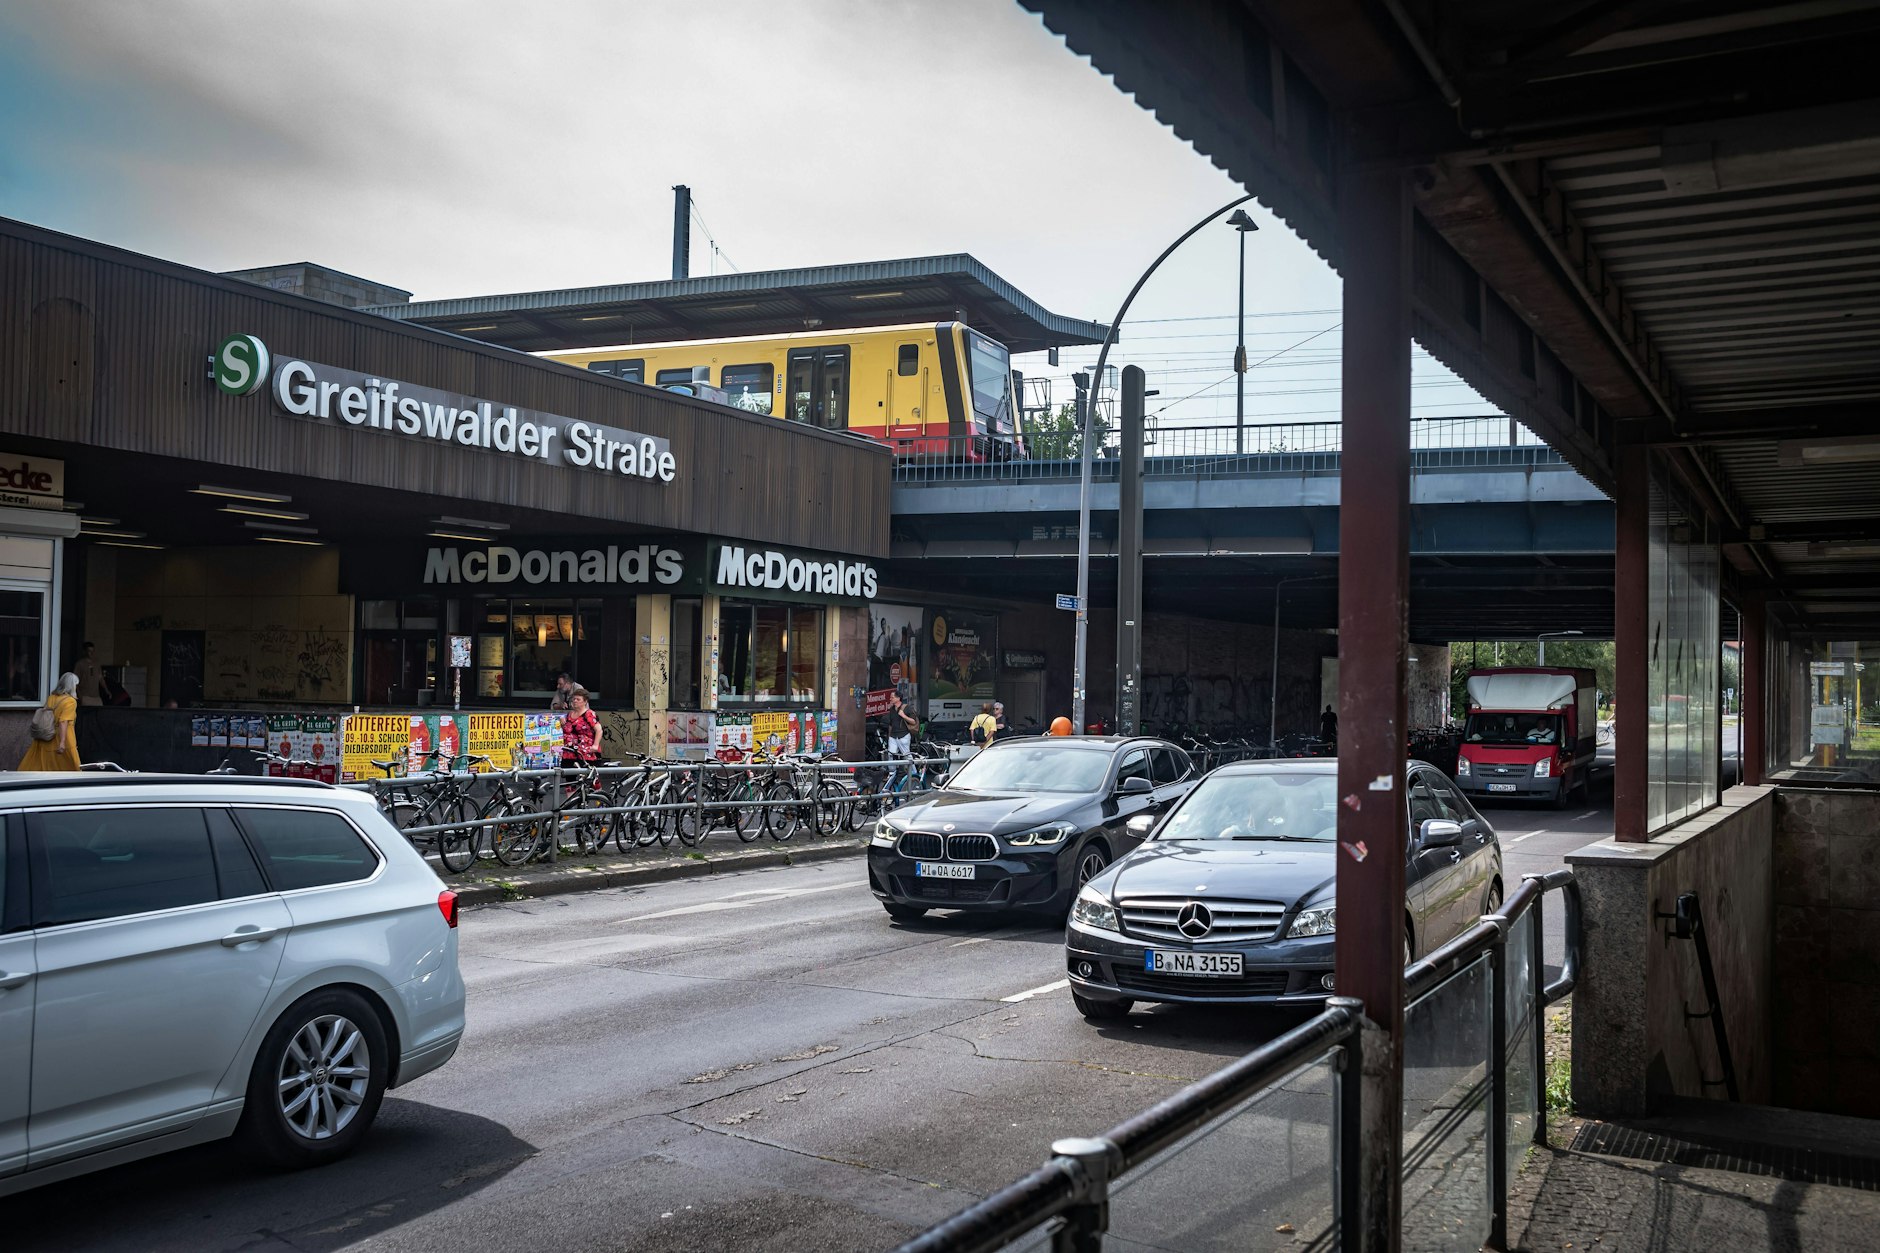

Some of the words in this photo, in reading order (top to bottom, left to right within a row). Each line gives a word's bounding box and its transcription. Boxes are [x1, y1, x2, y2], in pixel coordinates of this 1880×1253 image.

[221, 340, 251, 389] S
[273, 360, 557, 460] Greifswalder
[564, 422, 676, 483] Straße
[423, 545, 684, 584] McDonald's
[717, 545, 878, 599] McDonald's
[346, 716, 409, 732] RITTERFEST
[470, 715, 524, 730] RITTERFEST
[378, 733, 409, 743] SCHLOSS
[498, 730, 524, 740] SCHLOSS
[344, 744, 392, 754] DIEDERSDORF
[469, 740, 509, 751] DIEDERSDORF
[408, 741, 416, 772] KLIMA
[937, 865, 949, 876] QA
[951, 866, 974, 878] 6617
[1155, 953, 1164, 969] B
[1175, 955, 1195, 971] NA
[1200, 956, 1240, 973] 3155
